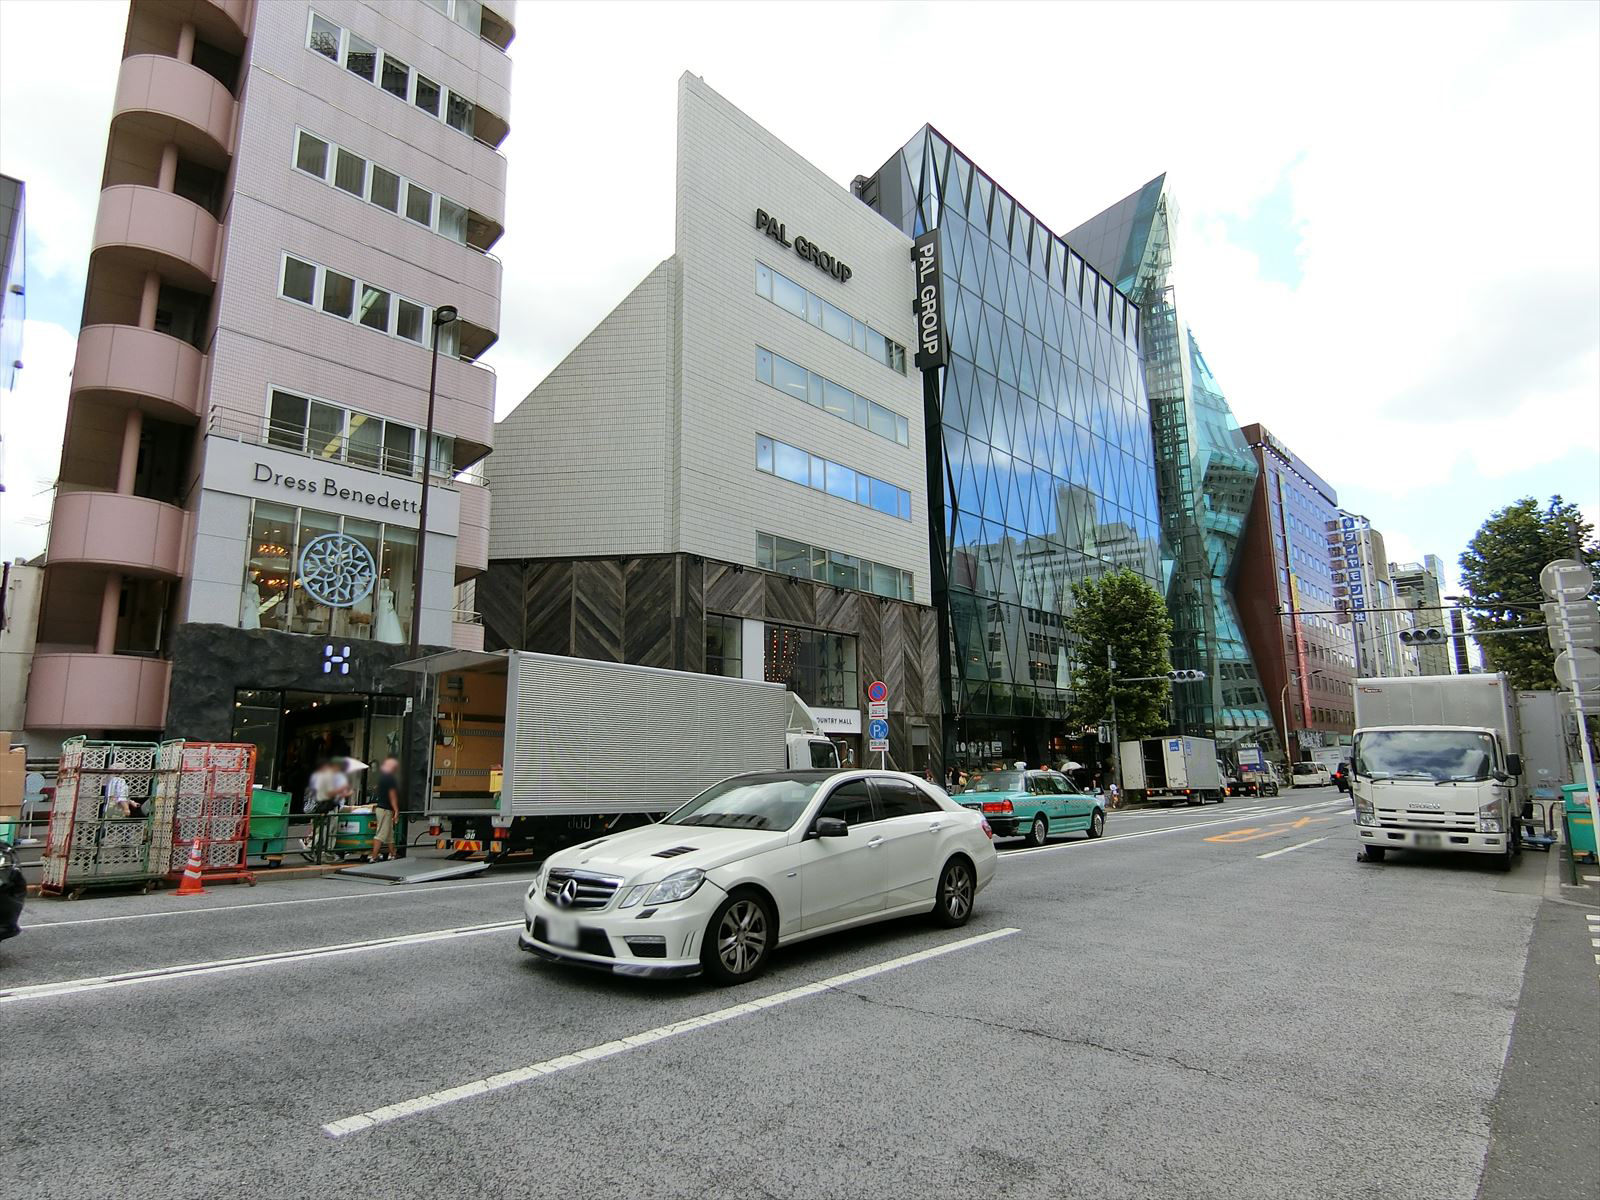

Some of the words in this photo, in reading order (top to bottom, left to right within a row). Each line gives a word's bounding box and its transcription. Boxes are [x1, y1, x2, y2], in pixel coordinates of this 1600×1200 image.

[756, 208, 792, 248] PAL
[794, 235, 853, 283] GROUP
[919, 242, 936, 284] PAL
[920, 285, 939, 355] GROUP
[253, 462, 318, 493] Dress
